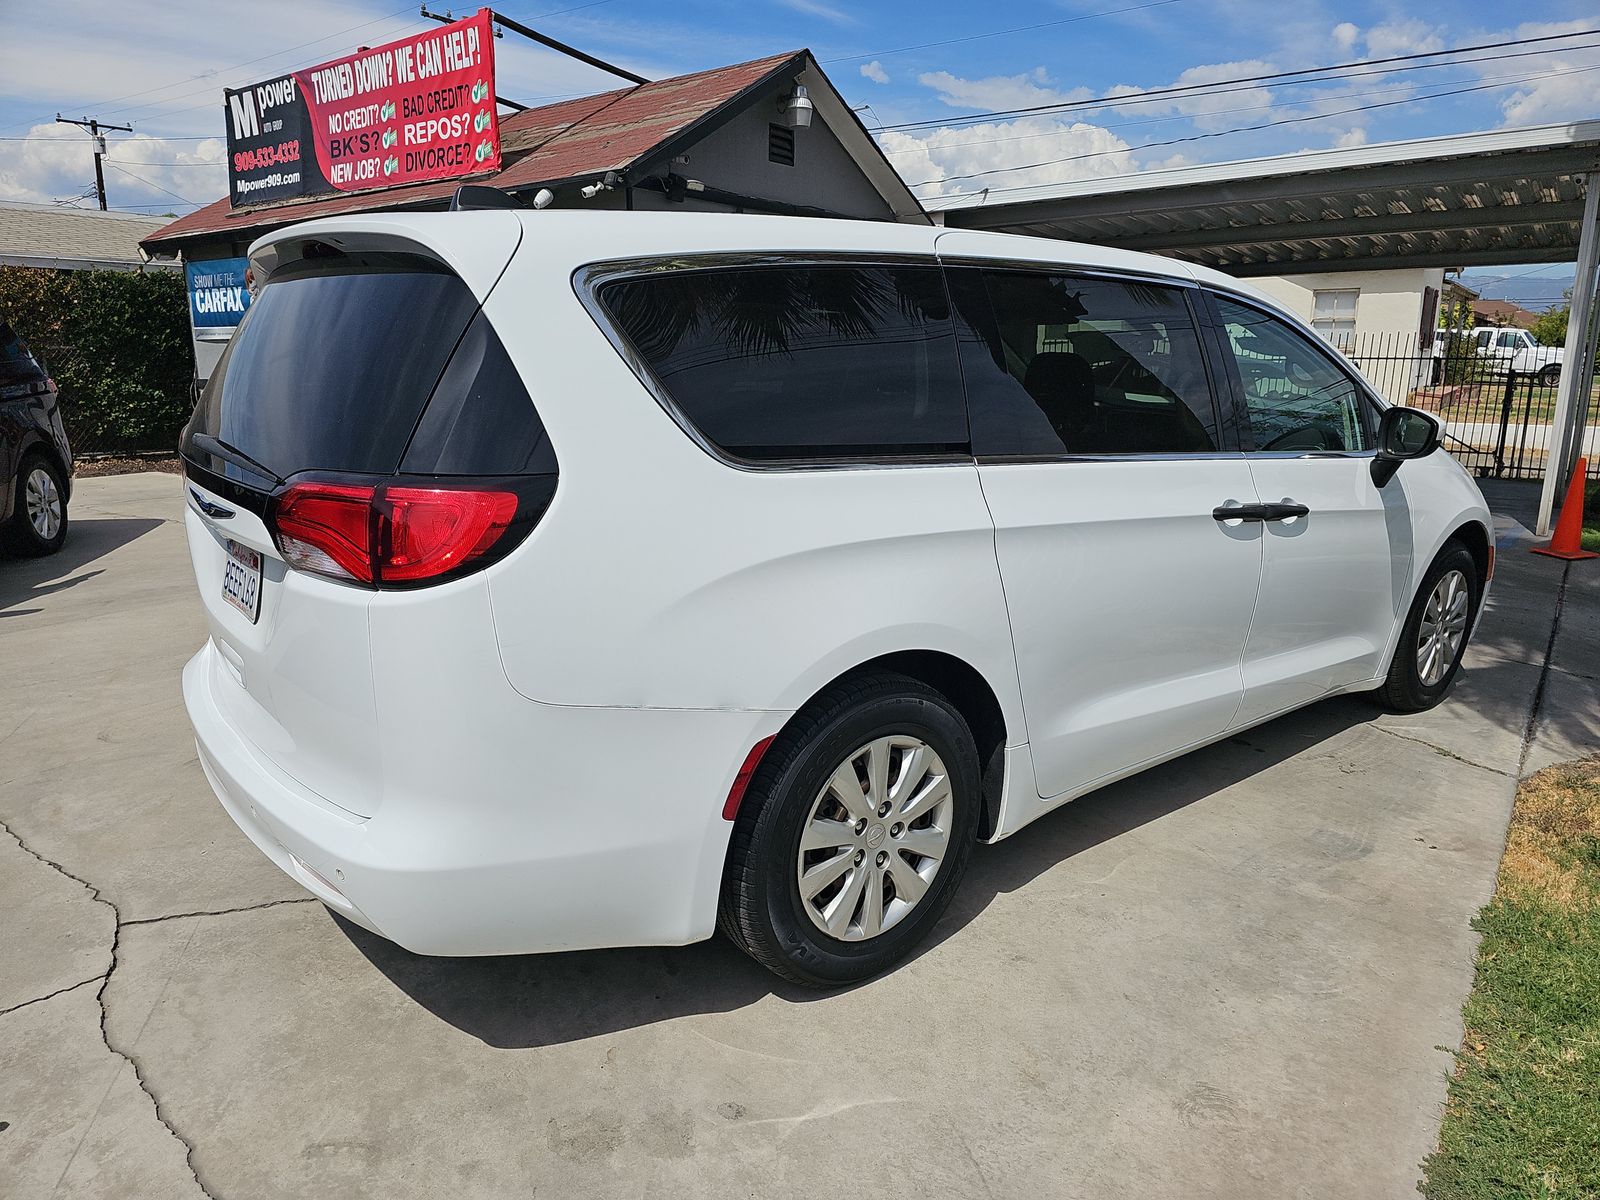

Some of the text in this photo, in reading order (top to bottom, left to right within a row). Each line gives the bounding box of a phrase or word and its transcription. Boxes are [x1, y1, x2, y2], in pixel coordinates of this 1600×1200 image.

[311, 26, 481, 105] TURNED DOWN? WE CAN HELP!
[229, 77, 296, 140] M power
[402, 84, 470, 118] BAD CREDIT?
[328, 104, 380, 135] NO CREDIT?
[404, 112, 471, 146] REPOS?
[234, 139, 300, 172] 909-533-4332
[330, 130, 380, 159] BK'S?
[405, 142, 471, 173] DIVORCE?
[236, 172, 300, 194] Mpower909.com
[331, 157, 381, 184] NEW JOB?
[194, 272, 235, 289] SHOW ME THE
[195, 286, 245, 314] CARFAX
[224, 559, 256, 610] 8EEF168
